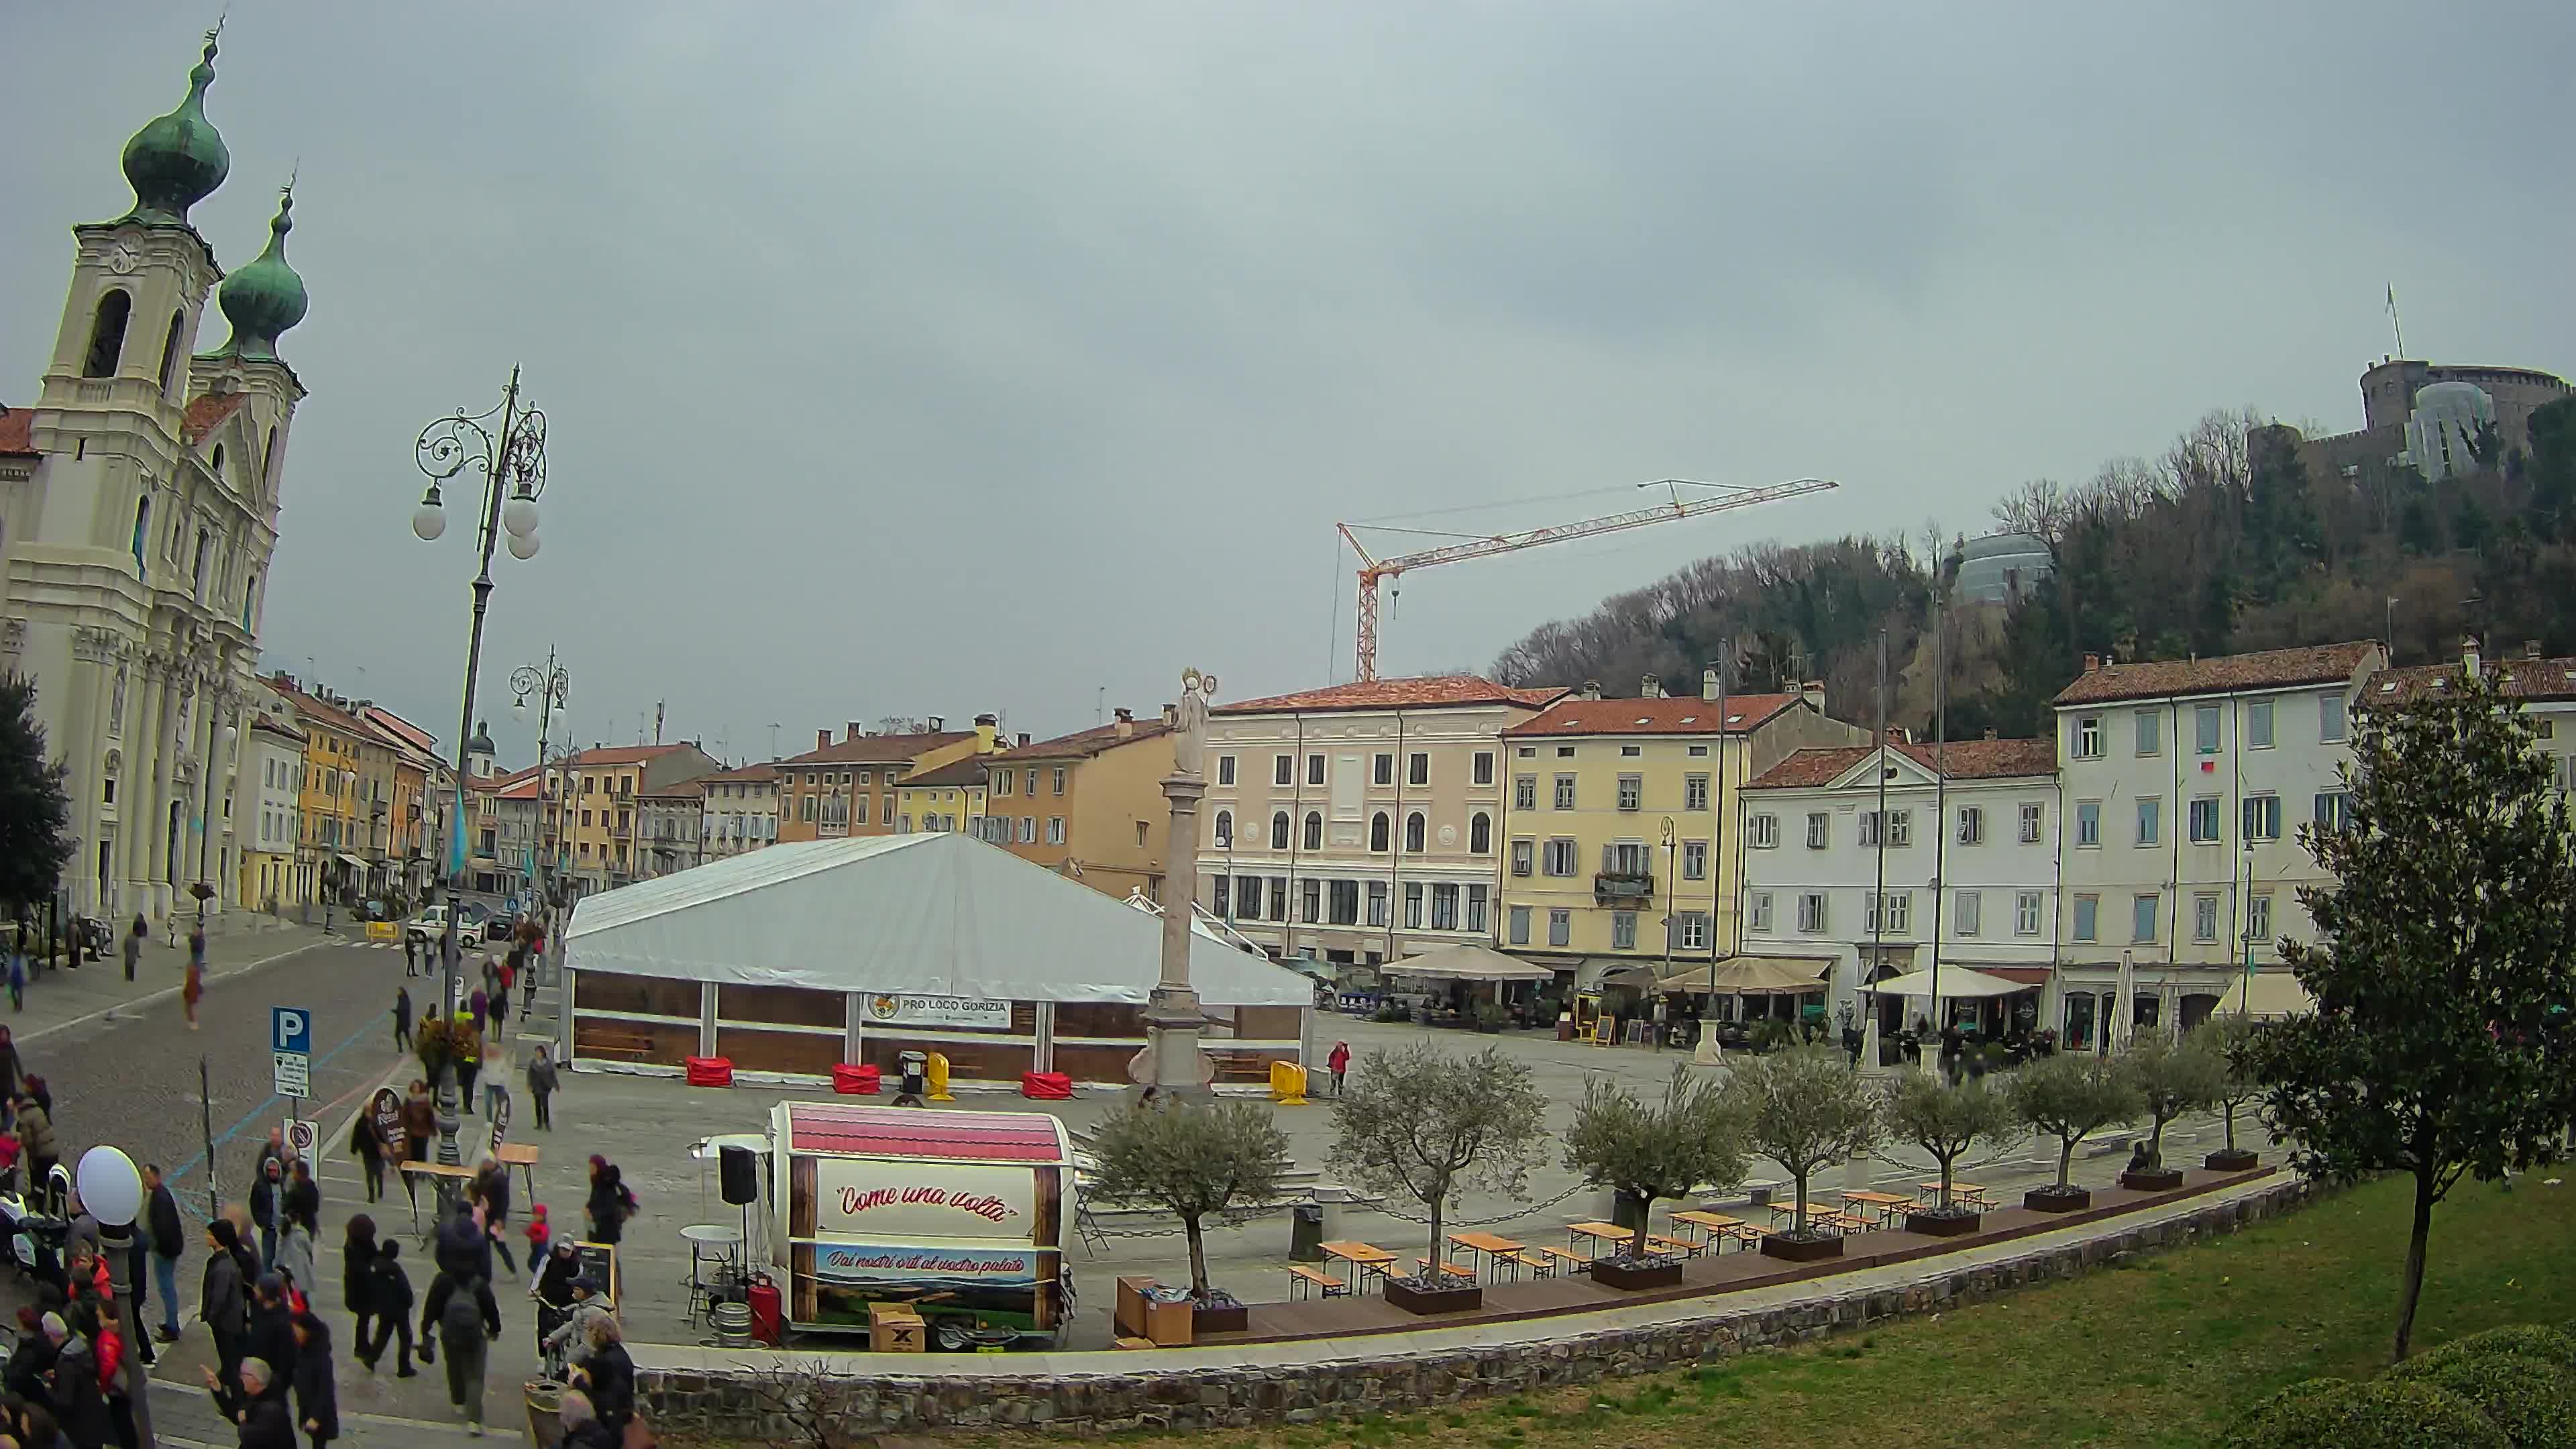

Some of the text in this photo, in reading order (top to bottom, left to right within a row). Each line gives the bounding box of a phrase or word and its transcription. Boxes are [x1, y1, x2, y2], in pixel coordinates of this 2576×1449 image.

[903, 1000, 1006, 1012] PRO LOCO GORIZIA
[279, 1011, 303, 1047] P
[901, 1186, 947, 1205] una
[827, 1250, 855, 1267] Dai
[855, 1253, 896, 1269] nostri
[921, 1255, 938, 1270] al
[937, 1257, 979, 1273] vostro
[977, 1255, 1025, 1276] palato
